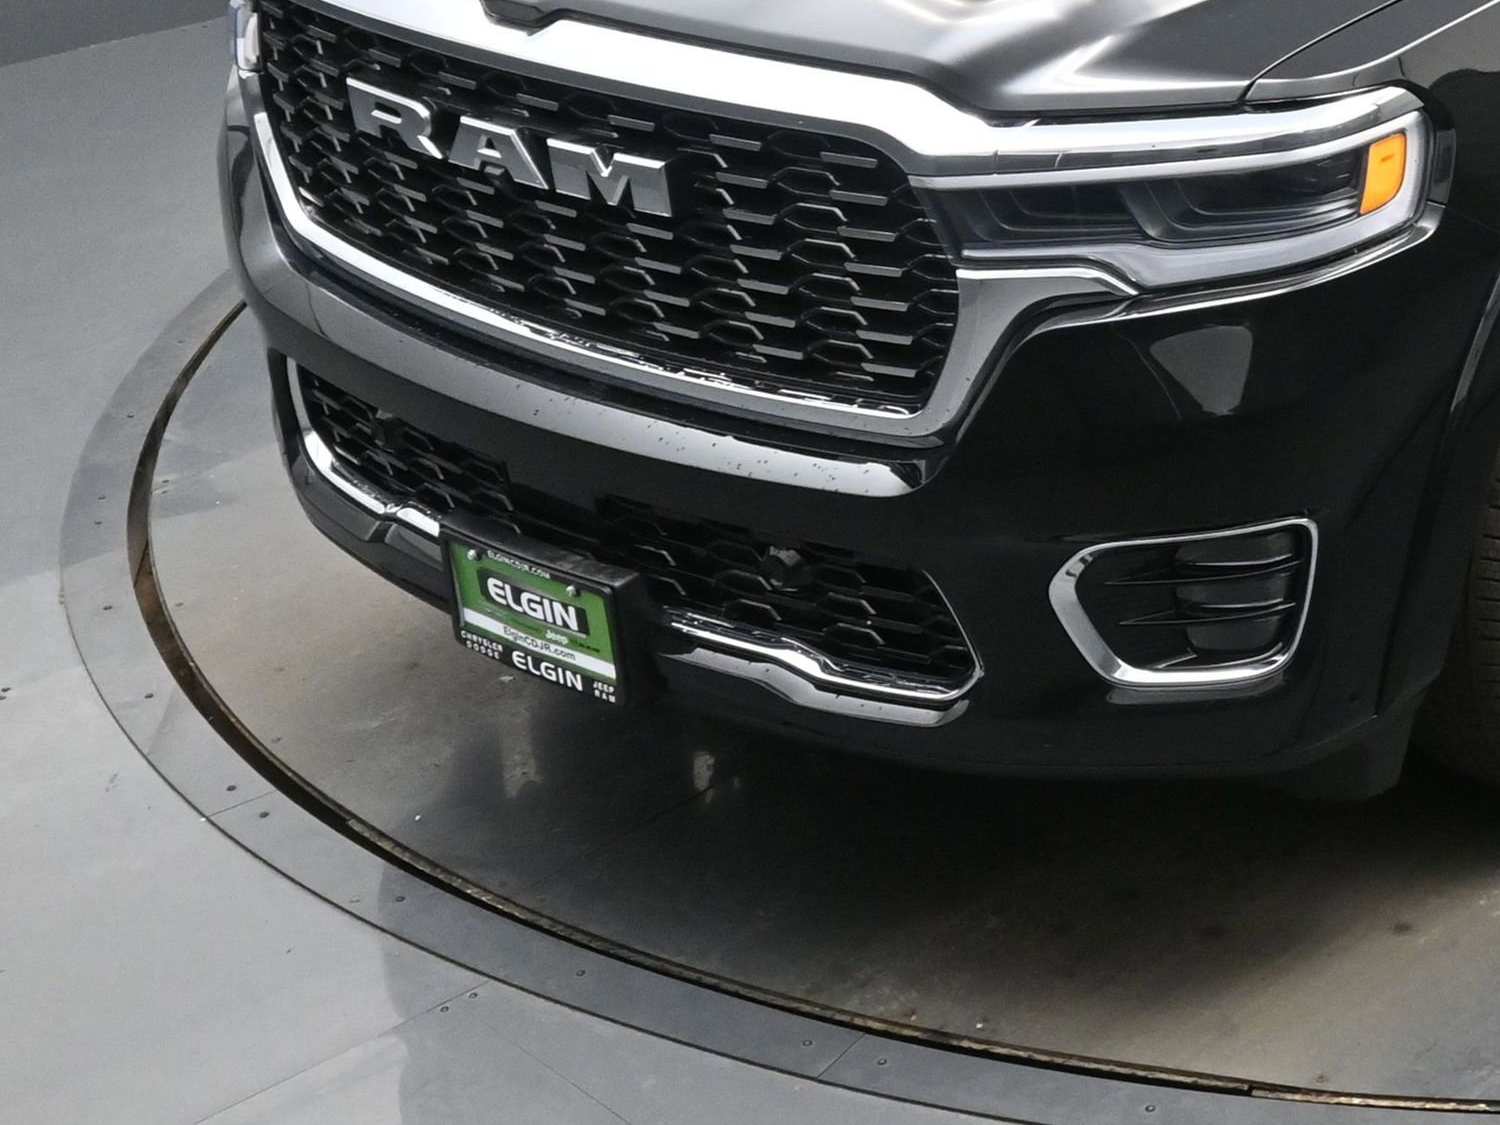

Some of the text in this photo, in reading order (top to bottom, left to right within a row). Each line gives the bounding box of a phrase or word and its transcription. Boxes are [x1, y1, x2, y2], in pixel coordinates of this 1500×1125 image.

[345, 75, 673, 217] RAM
[486, 576, 580, 632] ELGIN
[460, 629, 504, 653] CHRYSLER
[465, 639, 501, 660] DODGE
[502, 625, 577, 662] ElginCDJR.com
[511, 649, 584, 692] ELGIN
[592, 680, 615, 693] JEEP
